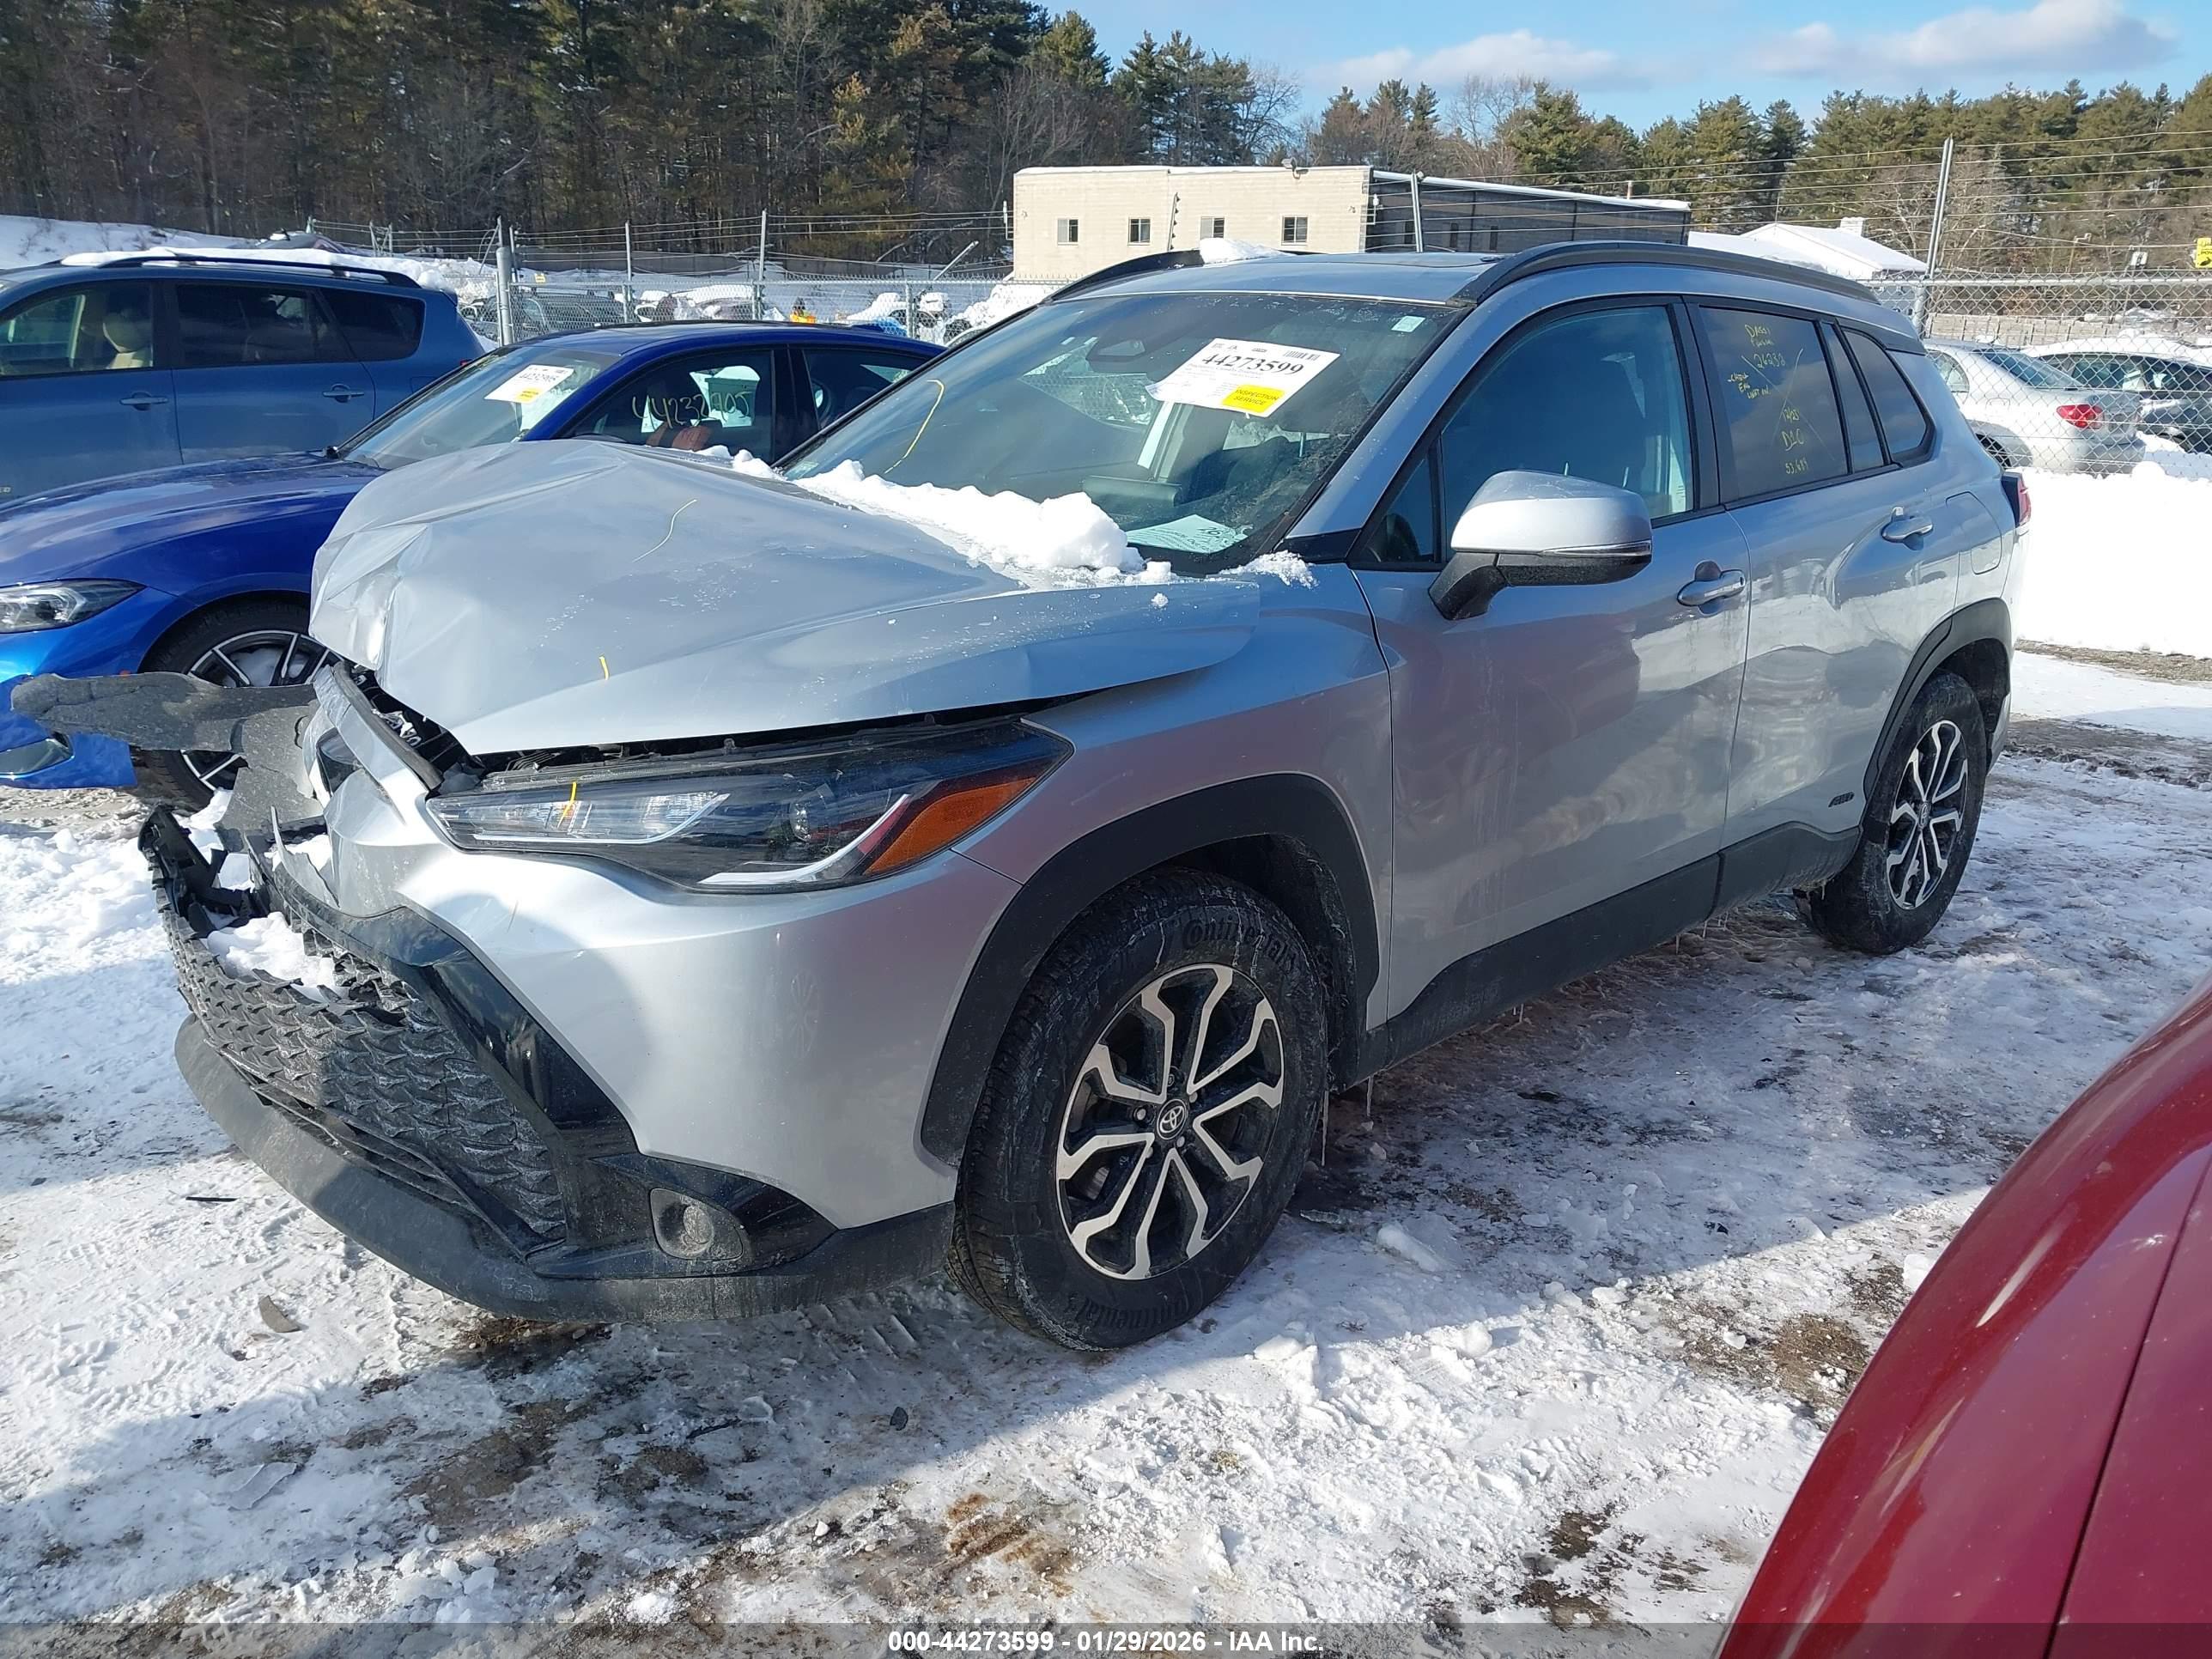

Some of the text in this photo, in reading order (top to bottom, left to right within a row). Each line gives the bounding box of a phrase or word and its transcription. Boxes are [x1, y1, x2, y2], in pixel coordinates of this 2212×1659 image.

[1202, 353, 1305, 375] 44273599
[1233, 395, 1267, 406] SERVICE
[1235, 389, 1279, 401] INSPECTION
[631, 391, 753, 431] 44232905
